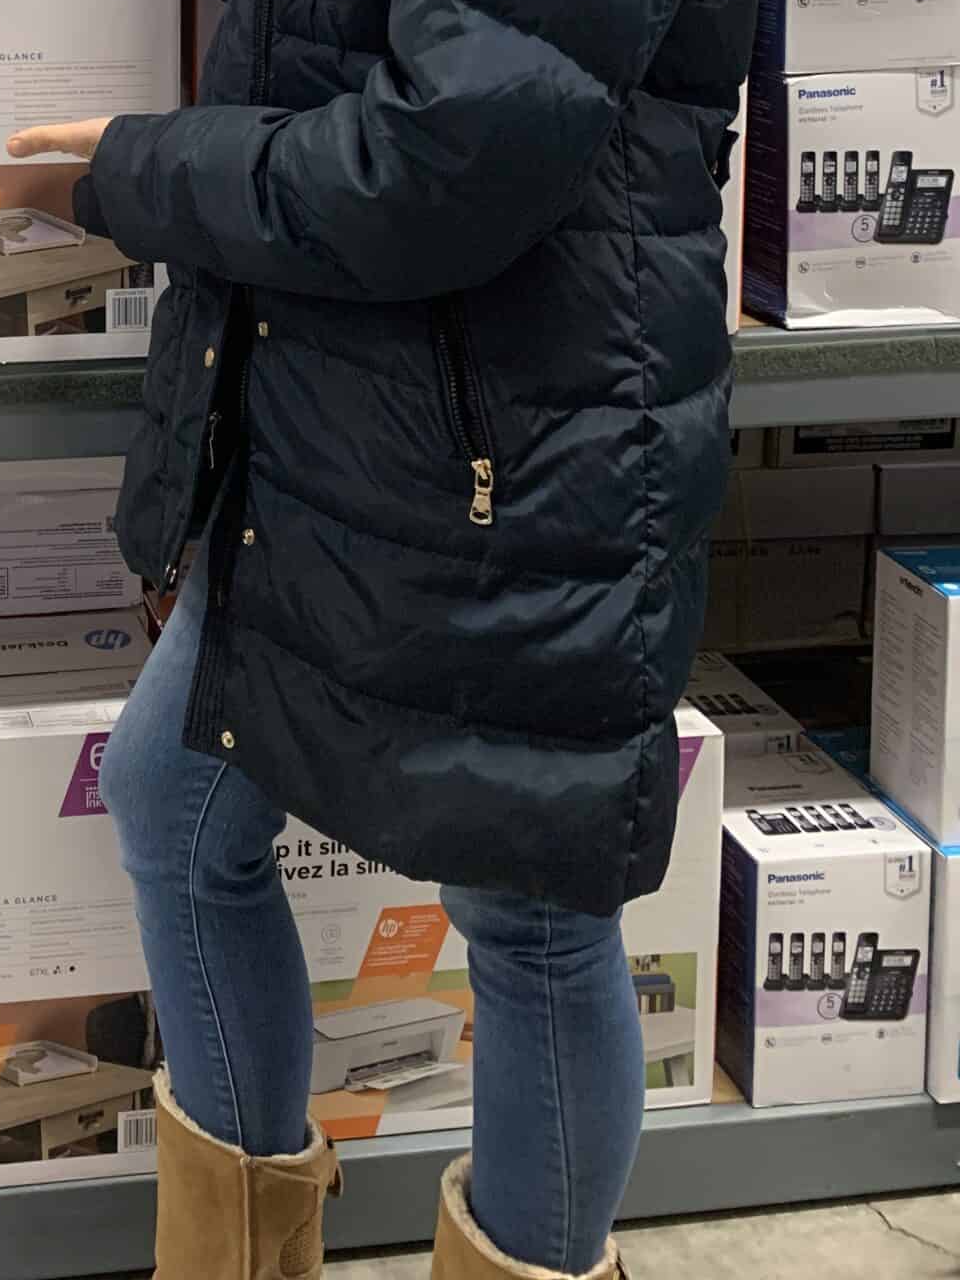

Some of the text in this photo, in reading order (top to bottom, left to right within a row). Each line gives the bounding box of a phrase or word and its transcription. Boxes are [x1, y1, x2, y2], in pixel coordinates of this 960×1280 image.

[0, 52, 44, 61] GLANCE
[798, 86, 856, 99] Panasonic
[860, 217, 869, 231] 5
[0, 639, 69, 651] DeskJet
[297, 840, 312, 856] it
[278, 863, 323, 880] ivez
[330, 860, 349, 876] la
[767, 871, 825, 884] Panasonic
[14, 894, 57, 905] GLANCE
[826, 995, 835, 1009] 5
